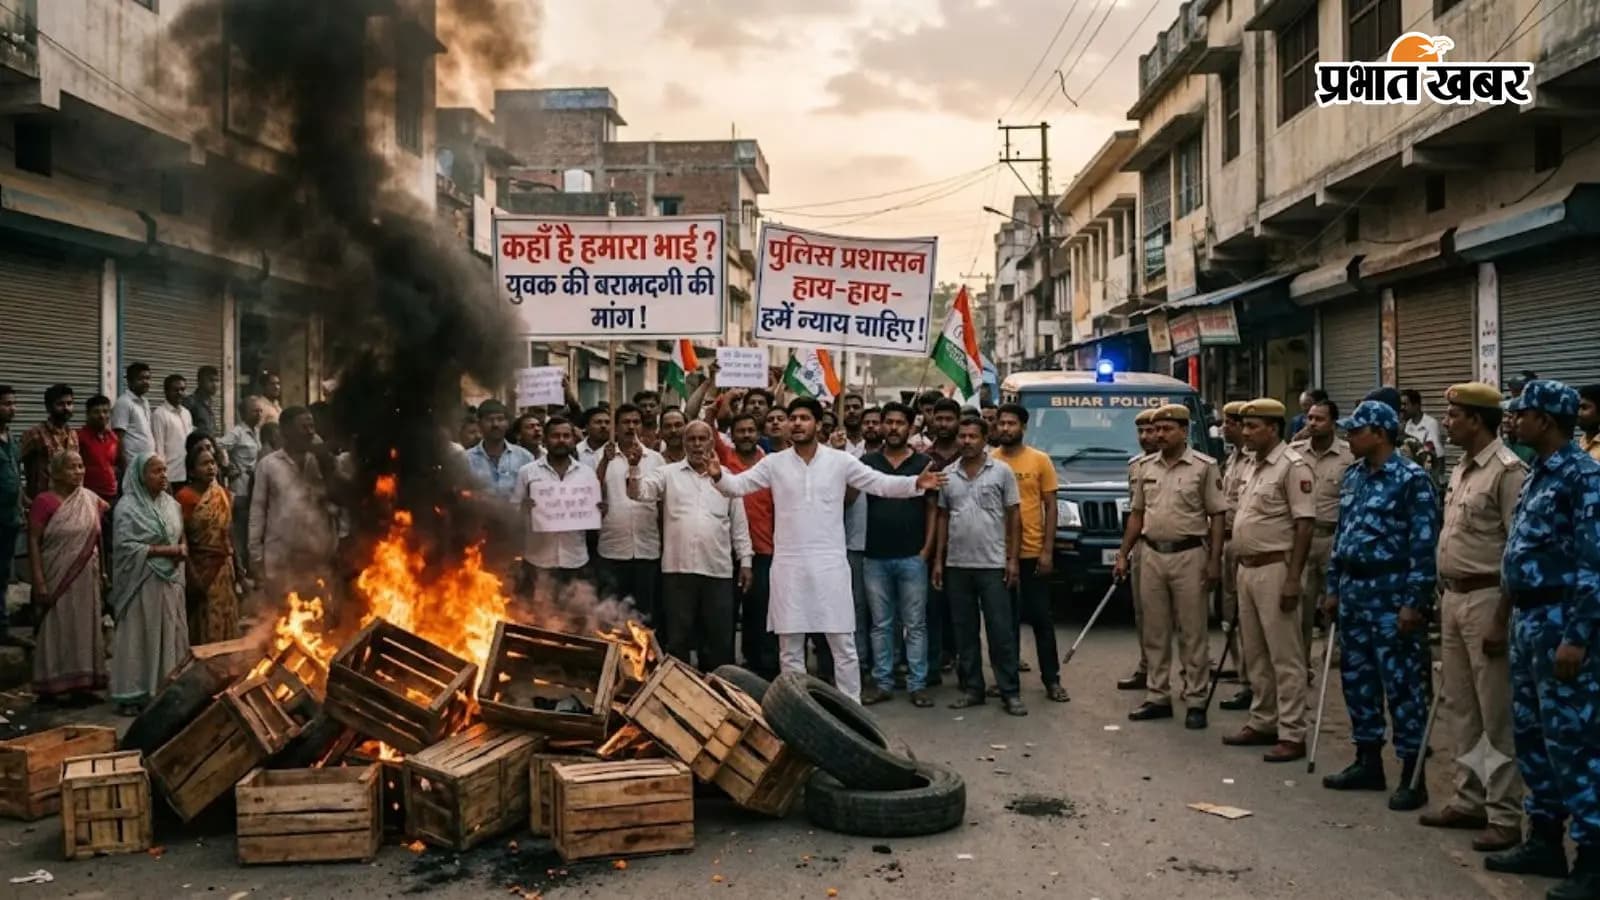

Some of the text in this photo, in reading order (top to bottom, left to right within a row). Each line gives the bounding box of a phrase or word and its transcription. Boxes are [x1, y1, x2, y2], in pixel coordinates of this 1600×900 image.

[501, 223, 552, 263] कहाँ
[555, 223, 575, 264] है
[579, 234, 648, 264] हमारा
[769, 235, 927, 274] पुलिस प्रशासन
[506, 266, 715, 305] युवक की बरामदगी की
[761, 301, 795, 331] हमें
[798, 311, 850, 334] न्याय
[1051, 396, 1170, 407] BIHAR POLICE
